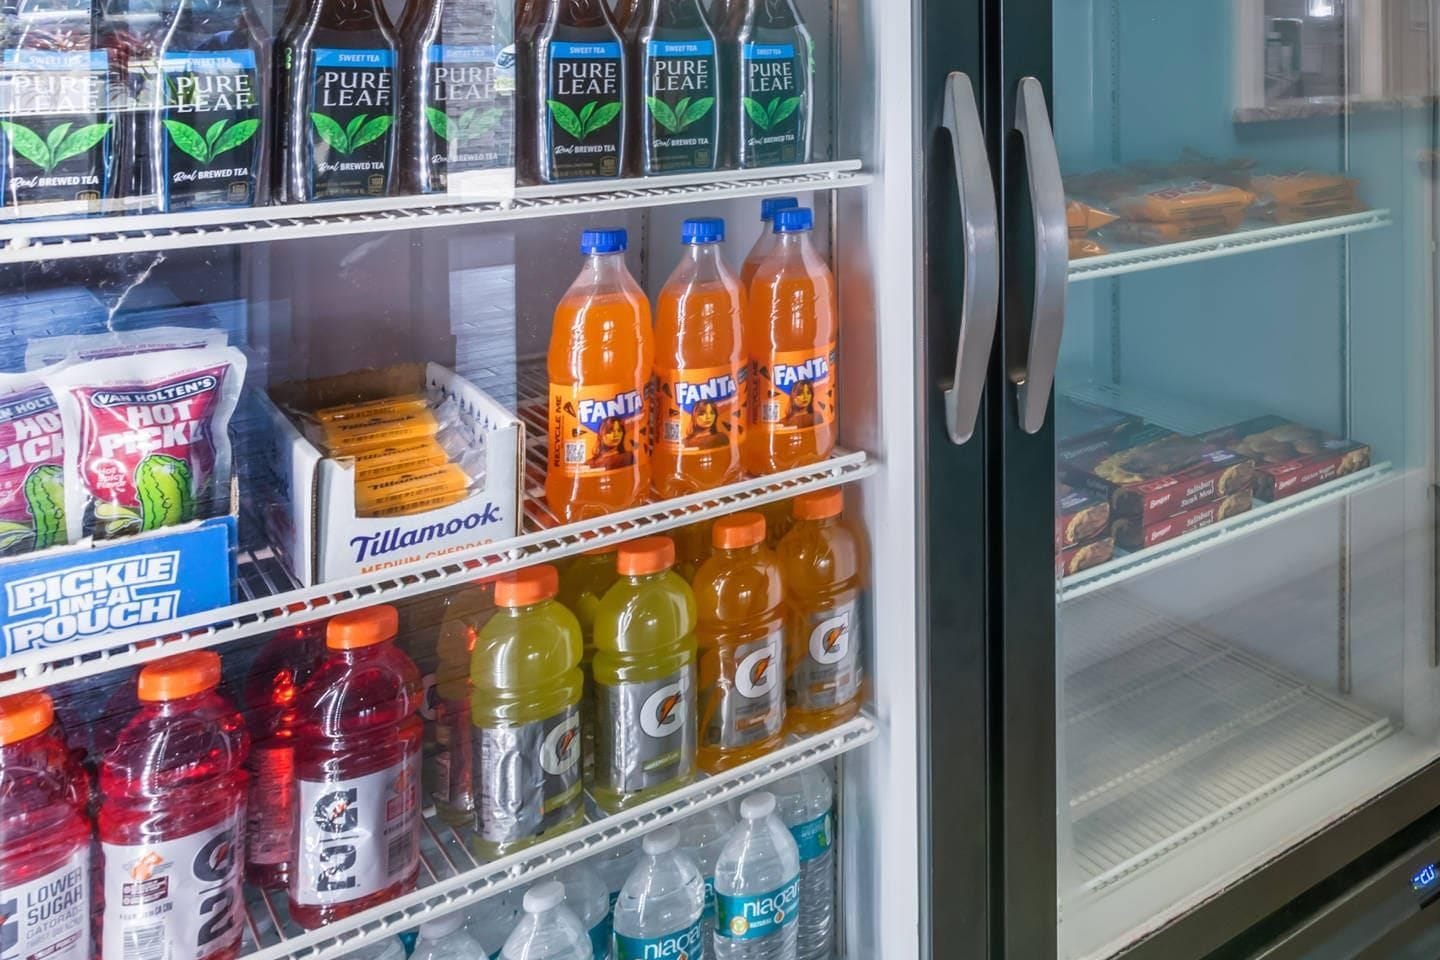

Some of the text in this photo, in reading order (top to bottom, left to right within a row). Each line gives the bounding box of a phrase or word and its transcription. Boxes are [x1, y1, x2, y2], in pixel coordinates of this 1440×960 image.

[338, 54, 365, 62] SWEET
[434, 67, 496, 84] PURE
[558, 63, 616, 78] PURE
[655, 60, 708, 75] PURE
[750, 62, 792, 77] PURE
[14, 76, 99, 94] PURE
[176, 74, 250, 94] PURE
[324, 72, 391, 89] PURE
[558, 79, 616, 94] LEAF
[655, 75, 708, 91] LEAF
[751, 76, 793, 91] LEAF
[323, 90, 390, 106] LEAF
[435, 84, 497, 100] LEAF
[177, 93, 251, 113] LEAF
[574, 145, 603, 153] BREWED
[604, 144, 616, 152] TEA
[340, 162, 370, 170] BREWED
[371, 161, 384, 169] TEA
[38, 177, 78, 186] BREWED
[82, 176, 99, 184] TEA
[173, 168, 248, 183] Real BREWED TEA
[774, 357, 829, 385] FANTA
[98, 377, 212, 404] VAN HOLTEN'S
[675, 376, 737, 404] FANTA
[556, 395, 562, 413] ME
[579, 390, 643, 424] FANTA
[126, 399, 194, 428] HOT
[350, 502, 501, 563] Tillamook
[15, 556, 173, 609] PICKLE
[13, 596, 172, 651] POUCH
[27, 866, 82, 908] LOWER
[27, 885, 82, 926] SUGAR
[744, 880, 800, 924] niagar
[644, 926, 700, 960] niaga
